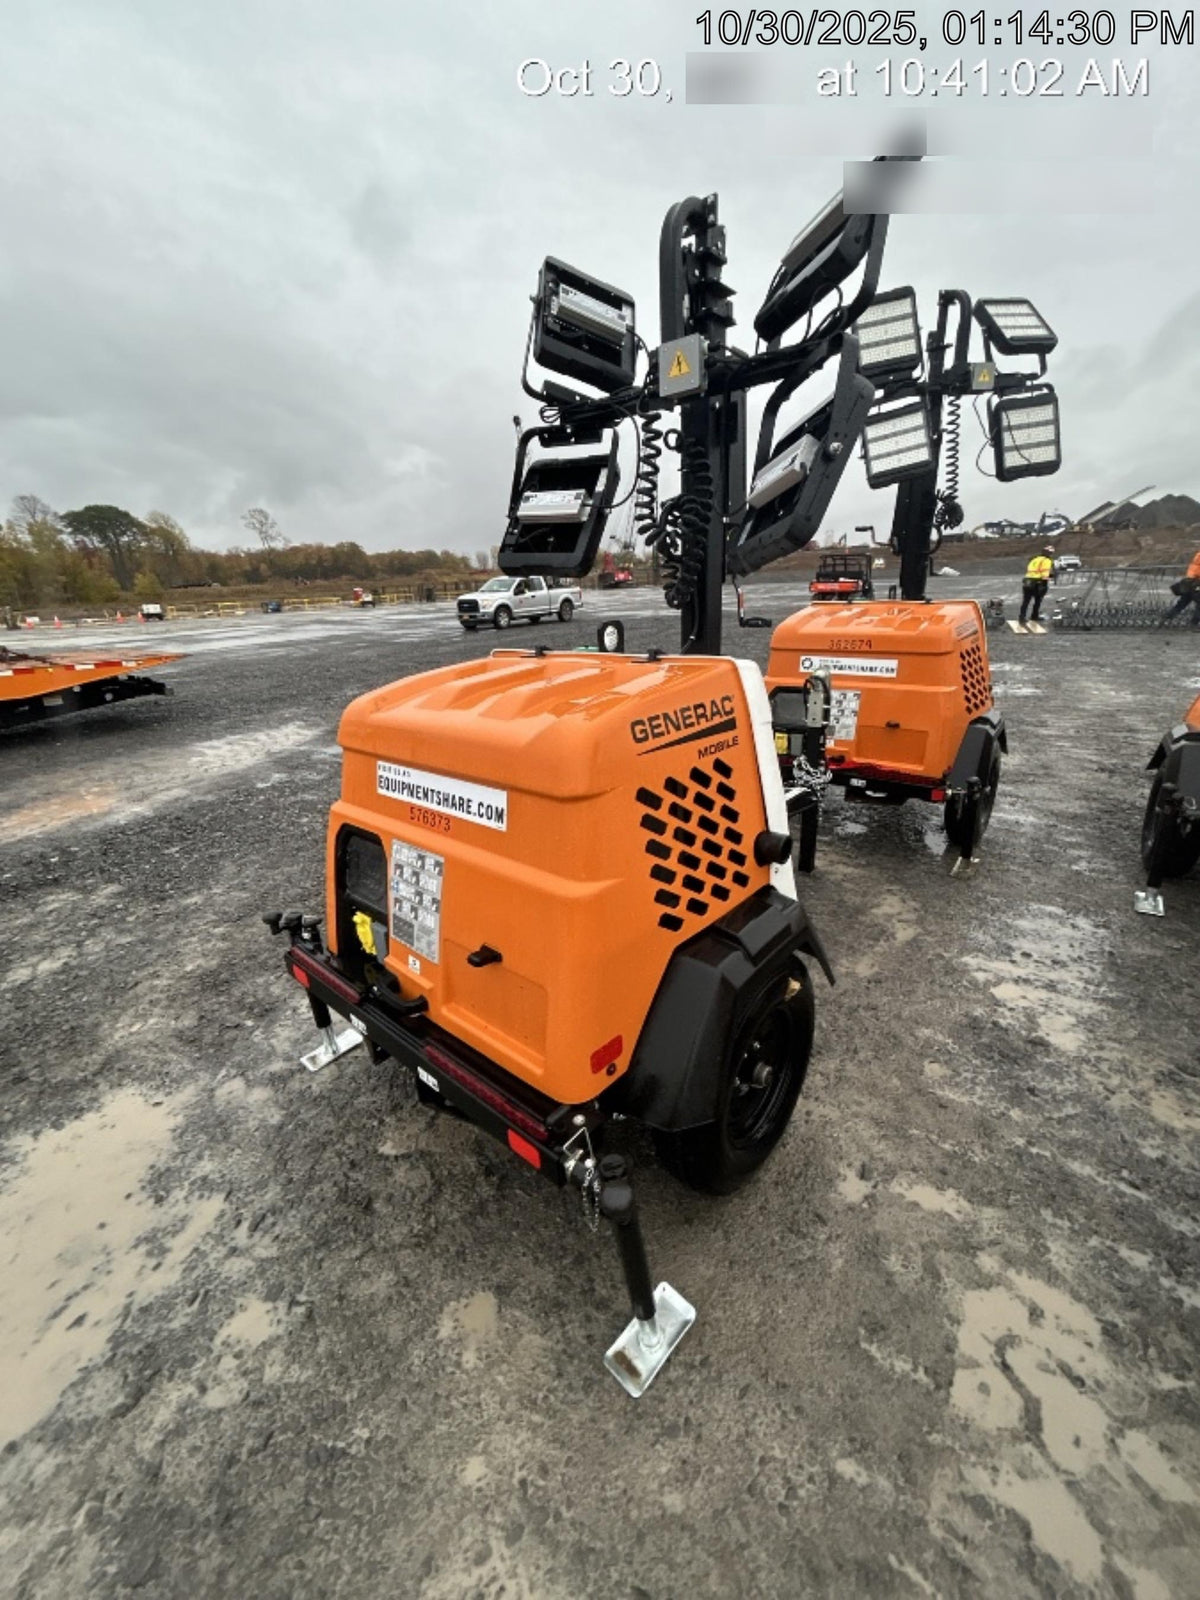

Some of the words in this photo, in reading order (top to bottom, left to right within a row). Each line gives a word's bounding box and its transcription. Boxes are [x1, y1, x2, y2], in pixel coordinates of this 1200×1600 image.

[630, 694, 734, 744] GENERAC
[697, 735, 739, 760] MOBILE
[378, 774, 505, 825] EQUIPMENTSHARE.COM
[409, 806, 451, 832] 576373
